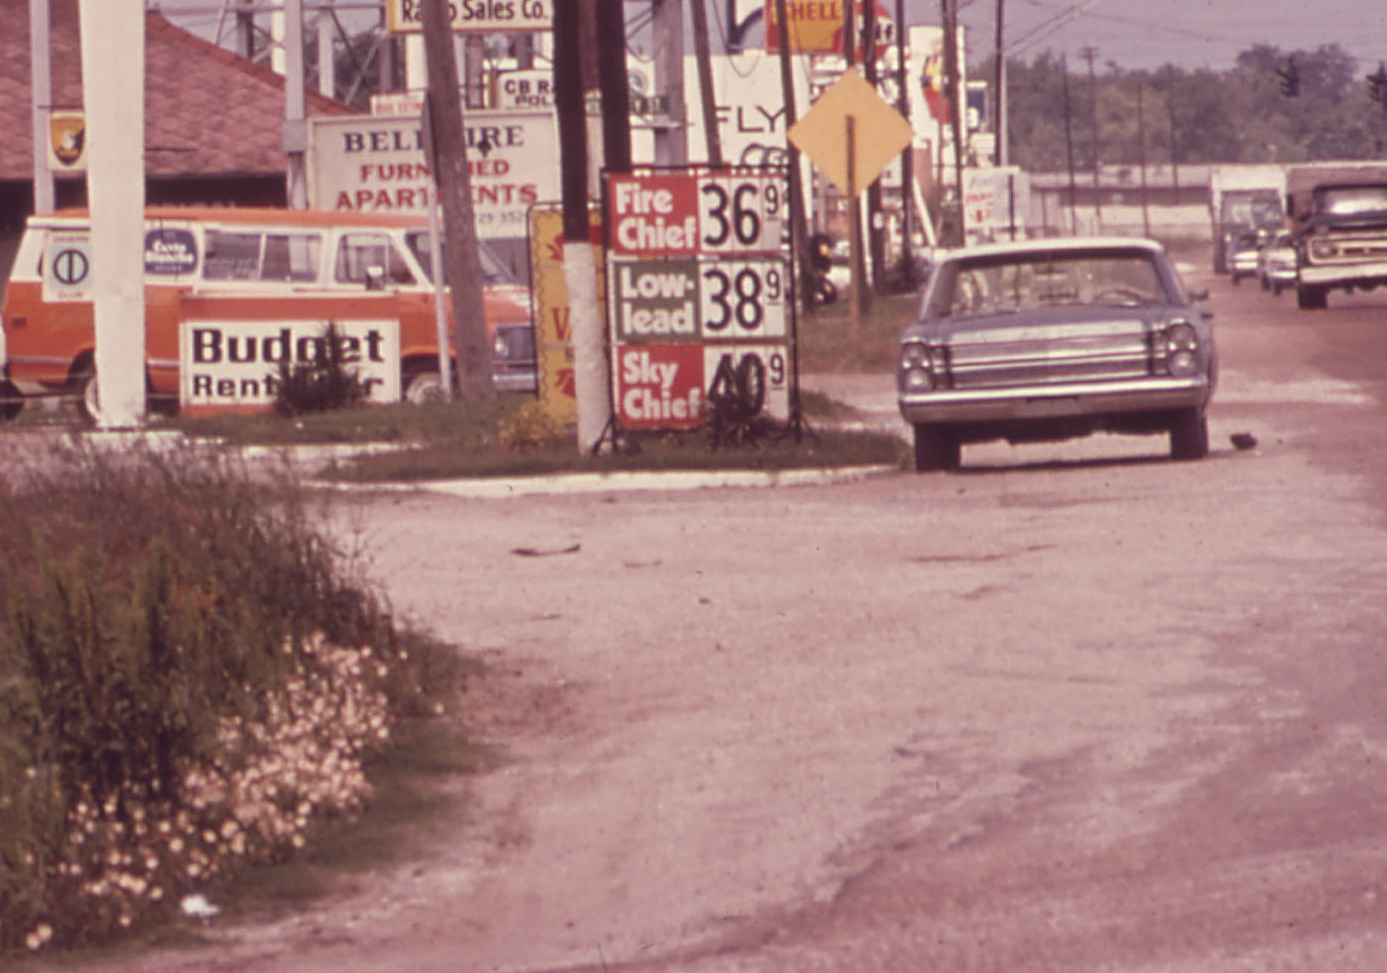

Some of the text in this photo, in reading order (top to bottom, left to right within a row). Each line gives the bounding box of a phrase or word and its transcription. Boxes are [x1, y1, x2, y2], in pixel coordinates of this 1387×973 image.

[786, 0, 842, 21] HELL
[614, 182, 674, 215] Fire
[616, 215, 698, 250] Chief
[622, 301, 695, 335] lead
[191, 326, 385, 369] Budget
[622, 350, 679, 389] Sky
[622, 386, 704, 420] Chief
